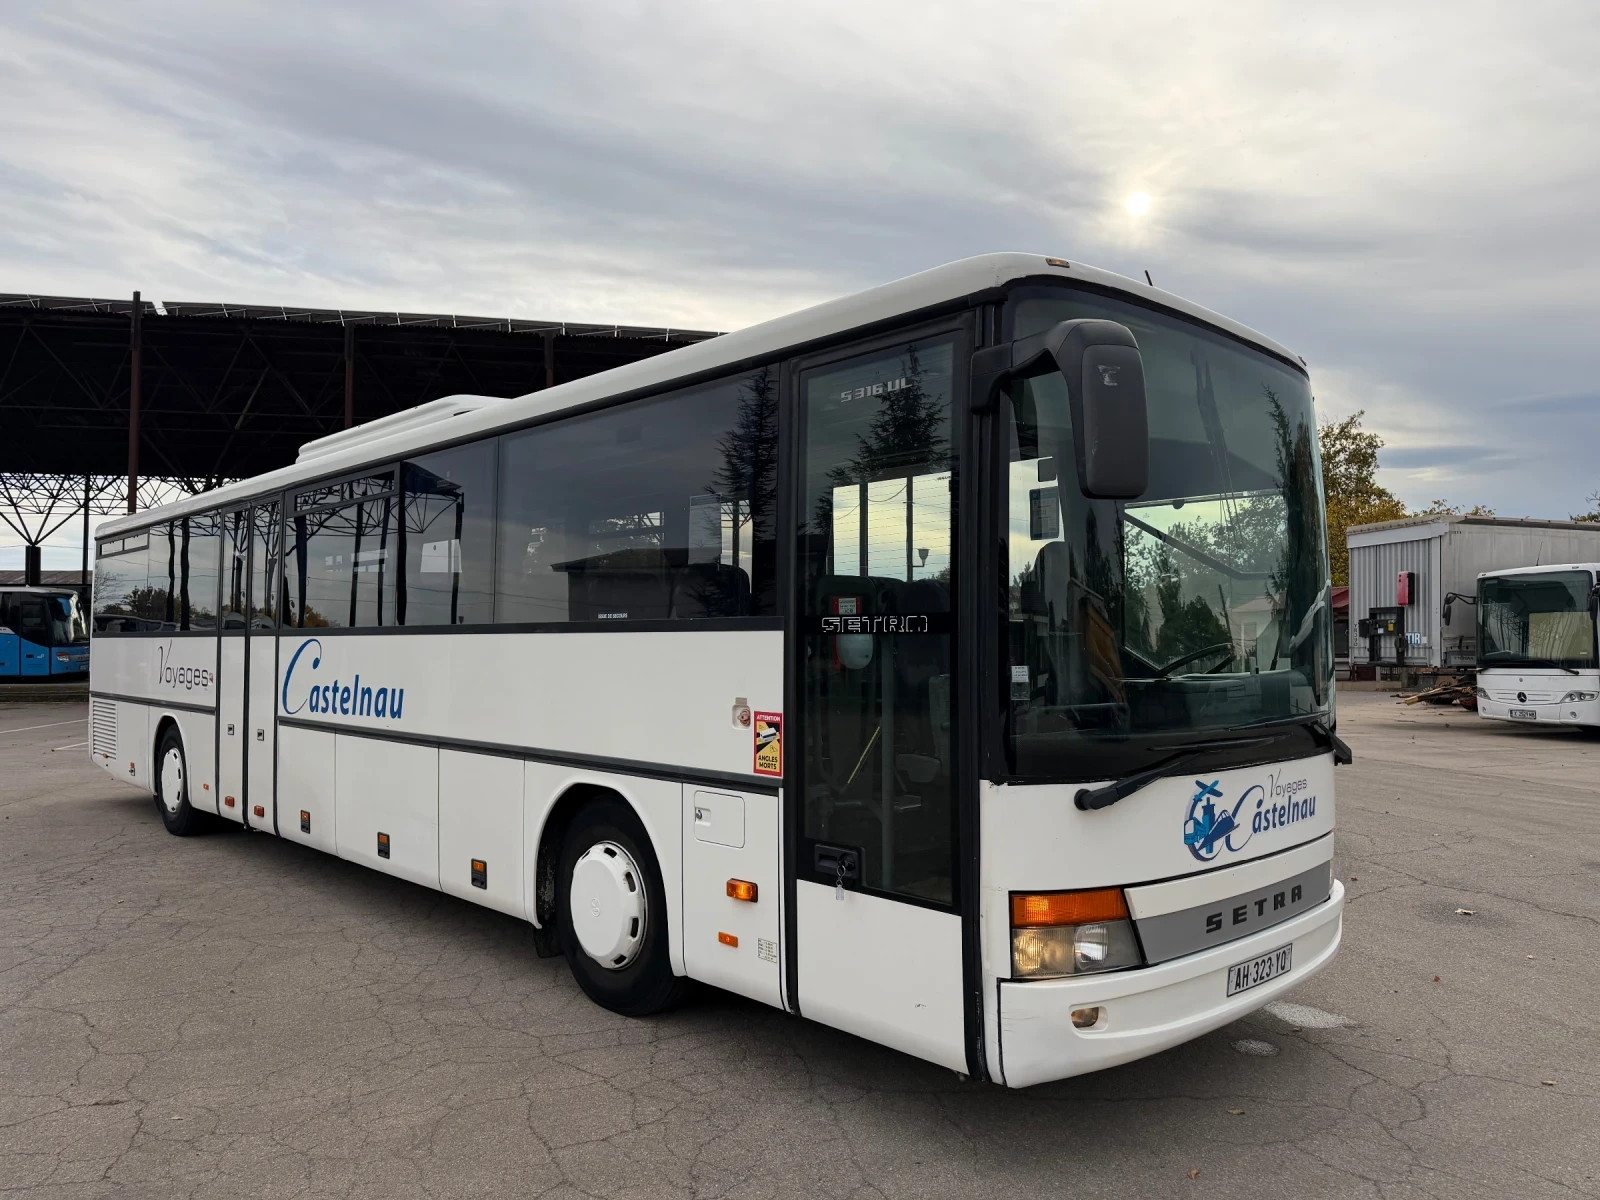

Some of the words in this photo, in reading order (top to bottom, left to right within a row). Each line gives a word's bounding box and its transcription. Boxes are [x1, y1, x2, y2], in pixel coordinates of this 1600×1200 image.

[1406, 632, 1421, 645] TIR
[157, 639, 209, 691] Voyages
[282, 638, 405, 720] Castelnau
[756, 714, 781, 722] ATTENTION
[758, 755, 778, 763] ANGLES
[759, 762, 777, 770] MORTS
[1268, 768, 1308, 800] Voyages
[1225, 784, 1316, 852] Castelnau
[1206, 884, 1302, 934] SETRA
